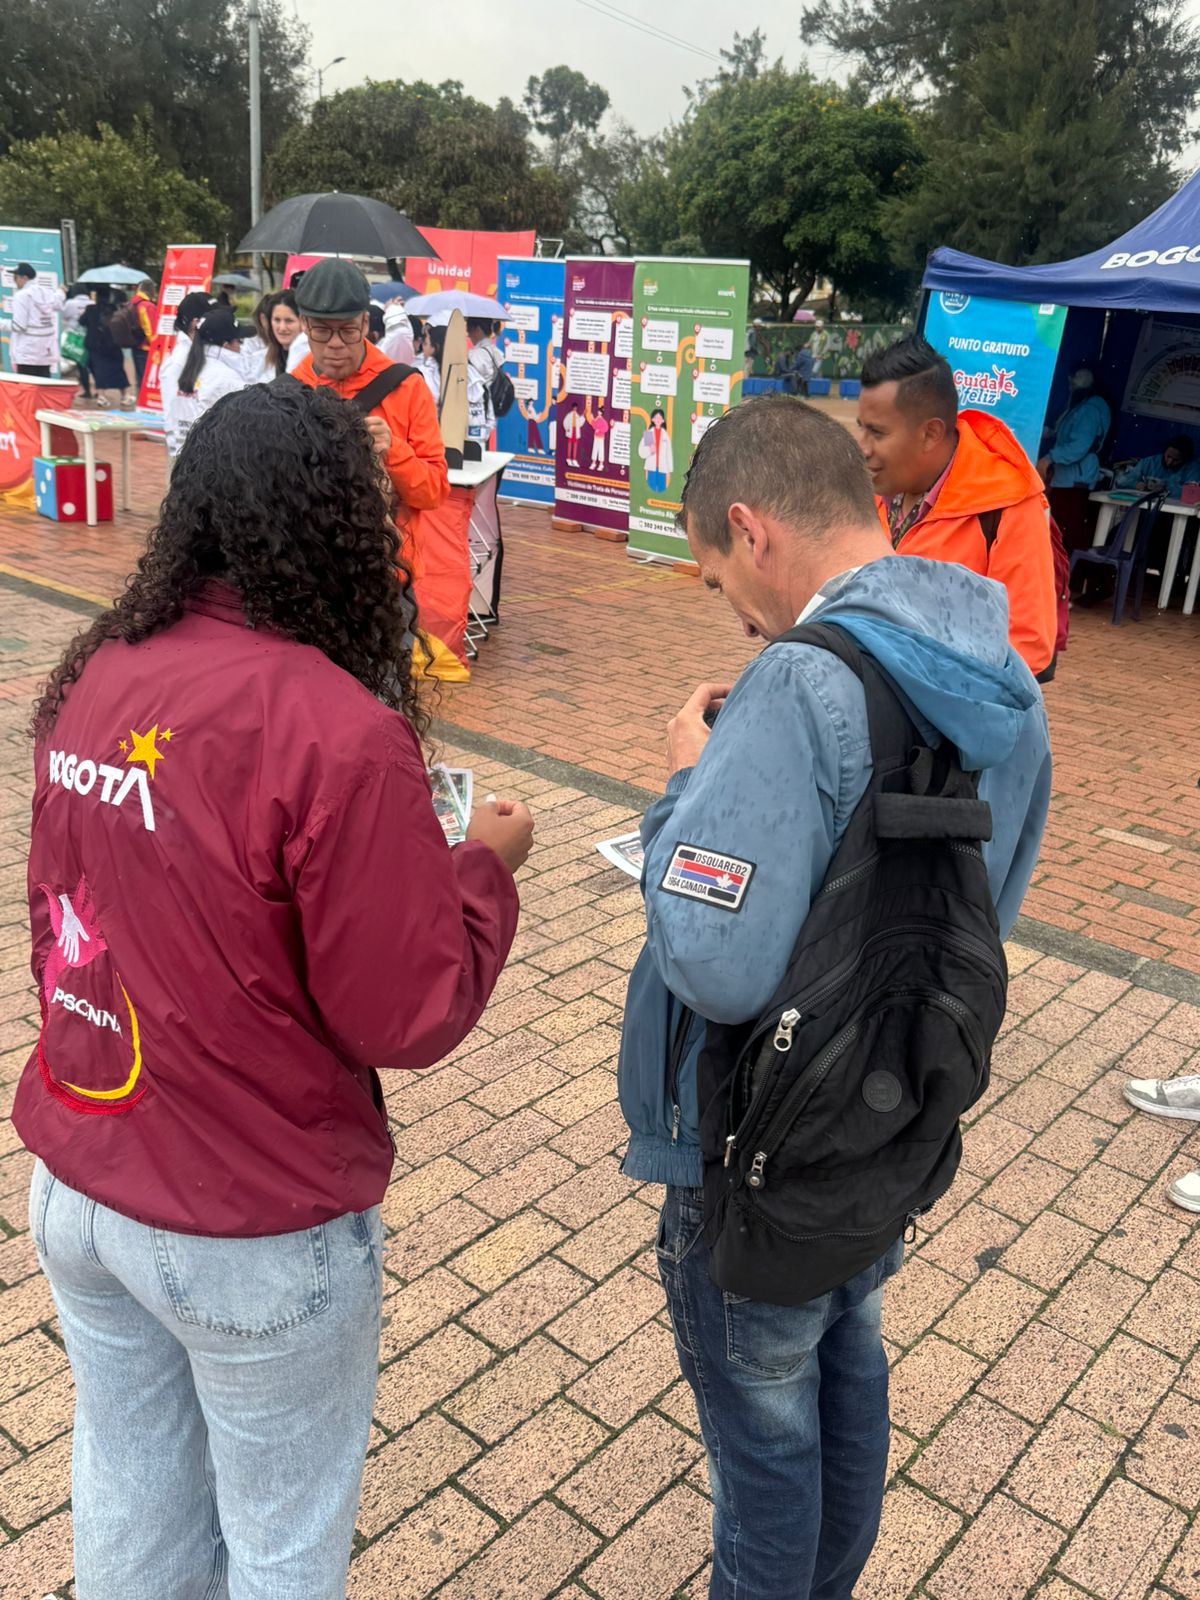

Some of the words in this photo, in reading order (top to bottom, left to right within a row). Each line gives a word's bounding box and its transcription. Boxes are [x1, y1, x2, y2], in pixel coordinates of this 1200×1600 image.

[427, 263, 472, 278] Unidad
[948, 336, 981, 351] PUNTO
[982, 341, 1030, 357] GRATUITO
[695, 853, 748, 876] DSQUARED2
[667, 876, 681, 887] 1964
[681, 880, 708, 895] CANADA
